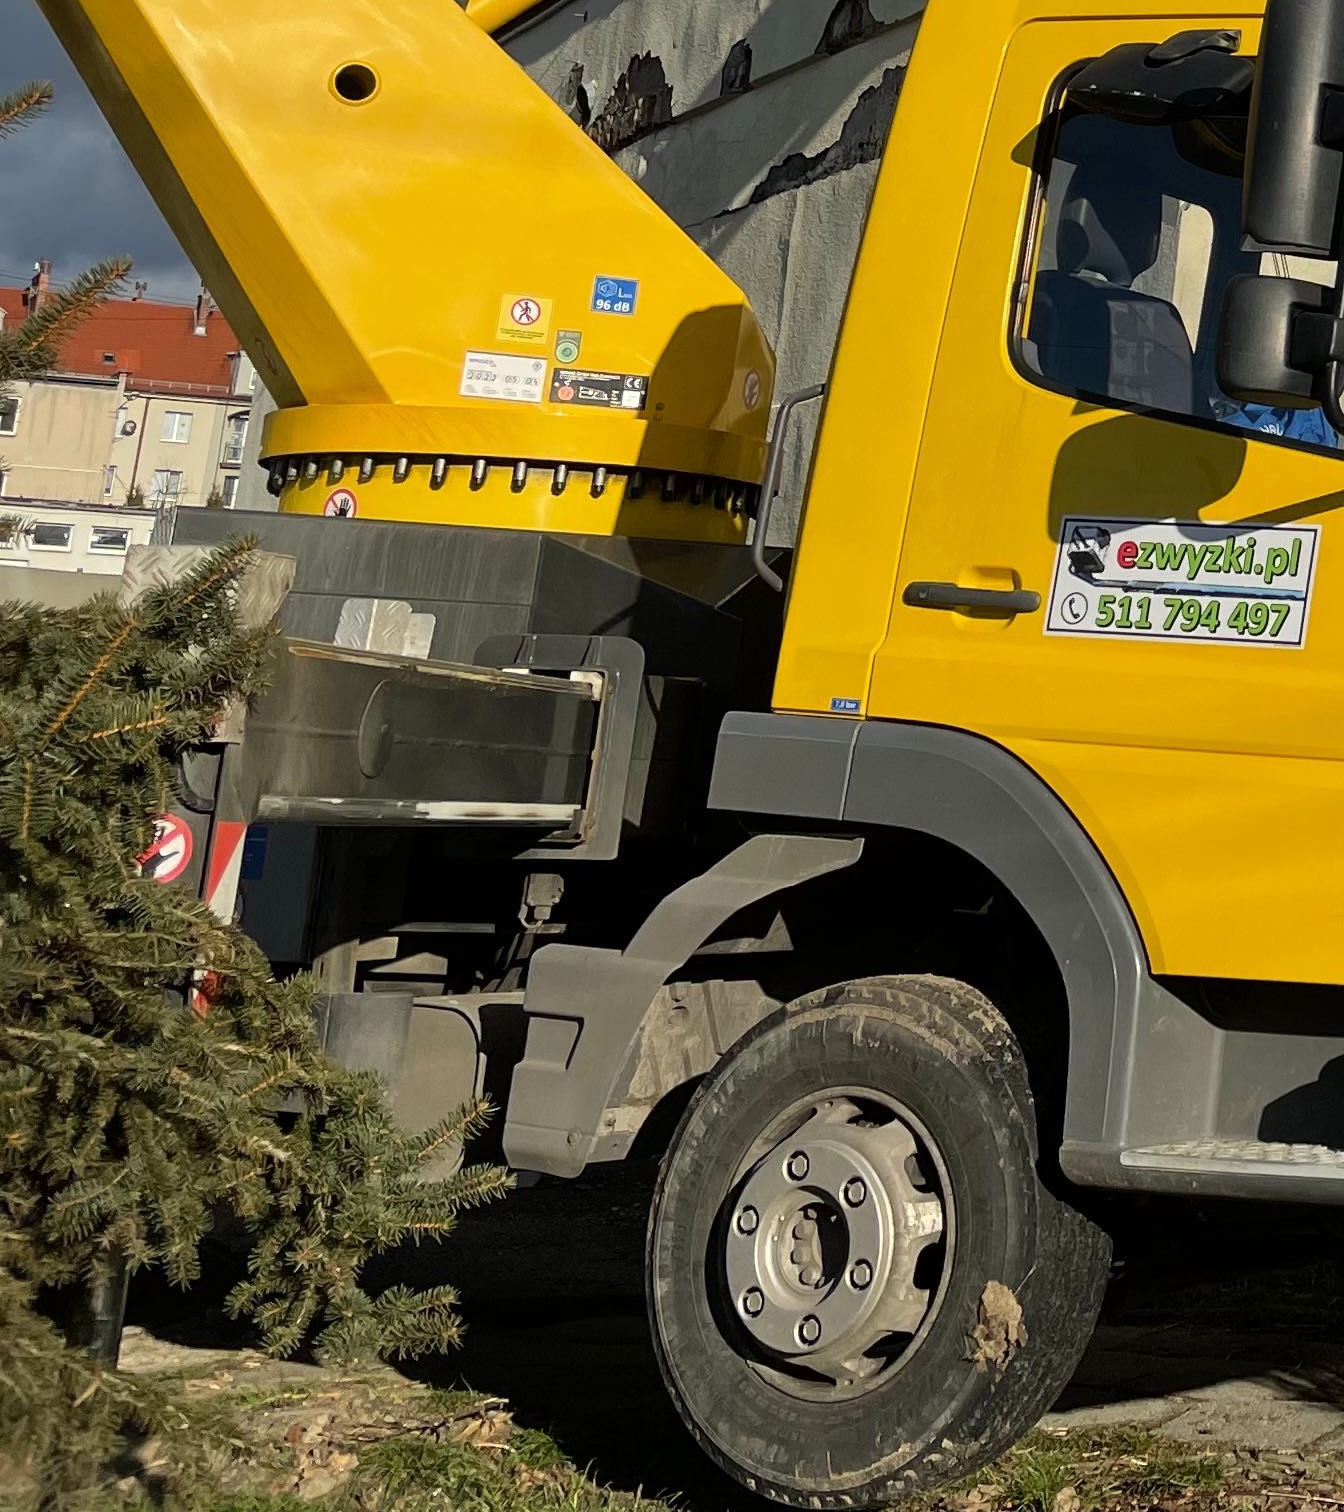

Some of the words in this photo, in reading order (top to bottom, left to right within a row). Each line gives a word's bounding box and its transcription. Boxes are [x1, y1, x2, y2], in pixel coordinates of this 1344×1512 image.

[596, 299, 611, 311] 96
[613, 300, 630, 312] dB
[1116, 535, 1302, 584] ezwyzki.pl
[1095, 594, 1152, 630] 511
[1163, 597, 1220, 634] 794
[1227, 601, 1290, 638] 497
